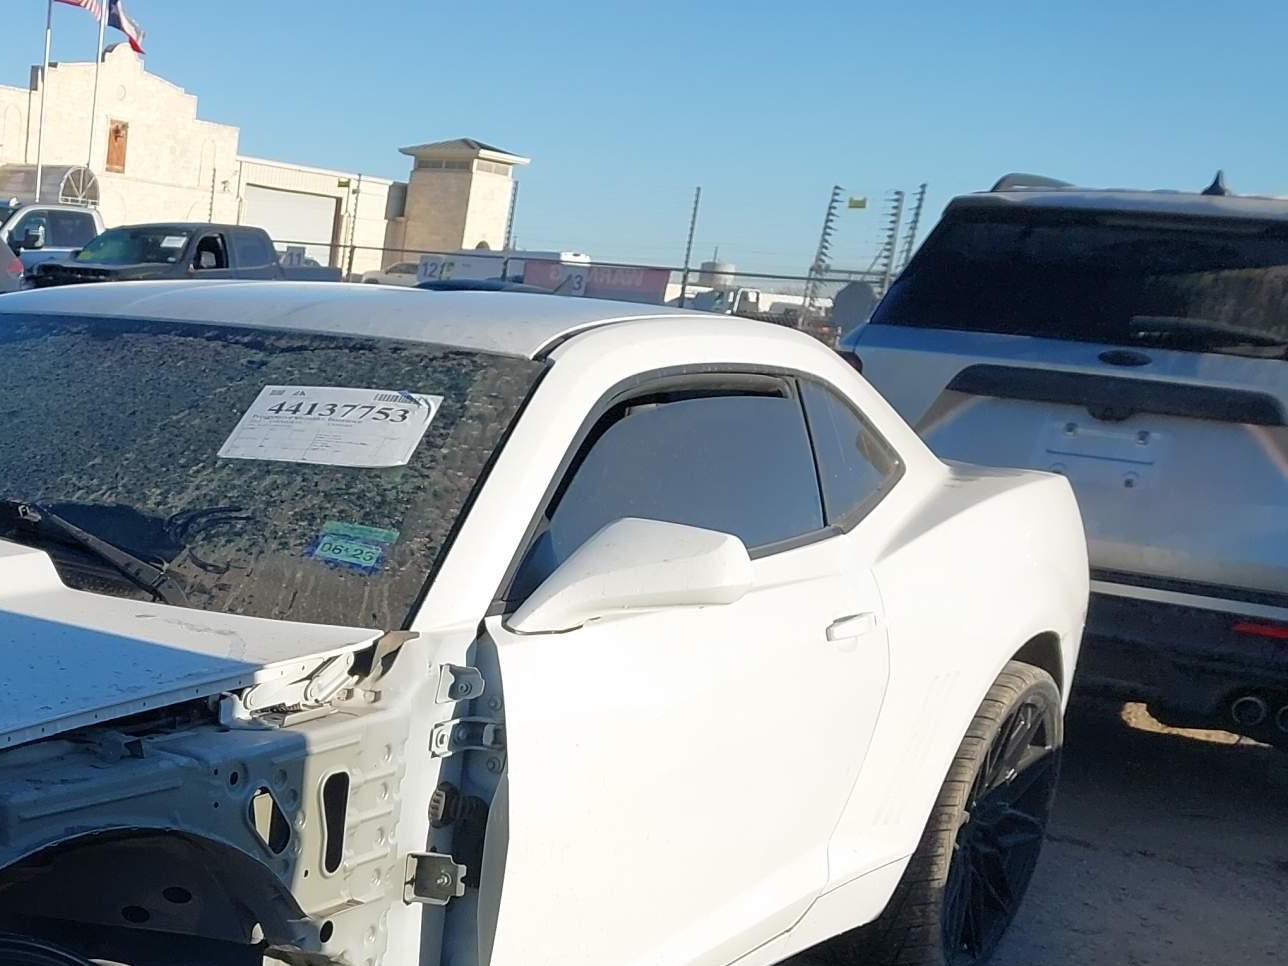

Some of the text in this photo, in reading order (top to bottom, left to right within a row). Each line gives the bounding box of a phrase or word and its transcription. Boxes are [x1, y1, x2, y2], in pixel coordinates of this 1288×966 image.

[288, 252, 302, 267] 11
[422, 262, 438, 278] 12
[268, 401, 410, 423] 44137753
[319, 542, 344, 555] 06
